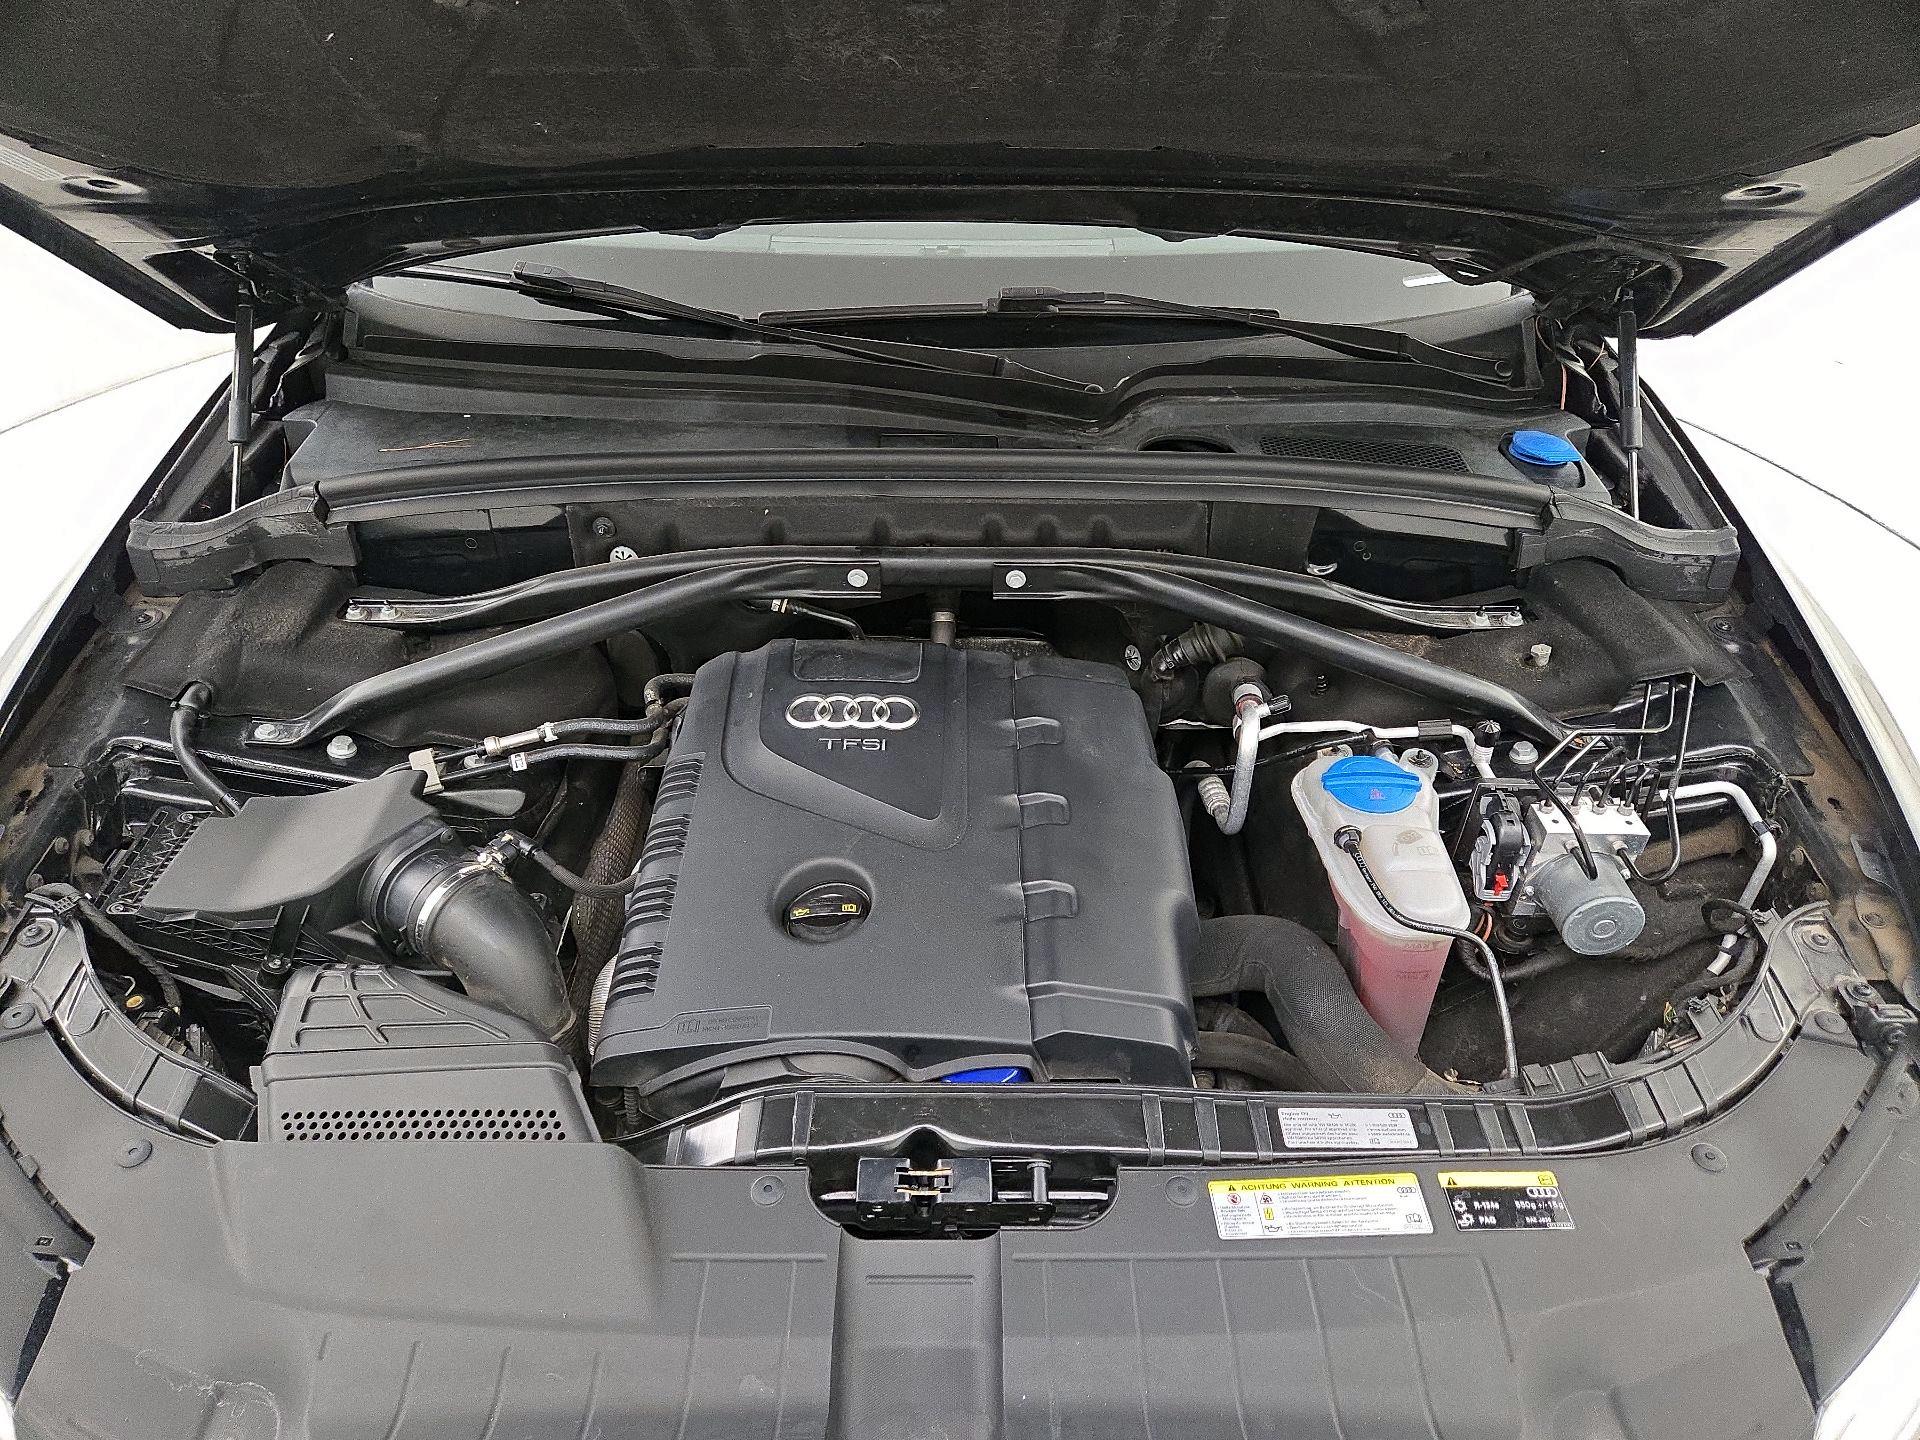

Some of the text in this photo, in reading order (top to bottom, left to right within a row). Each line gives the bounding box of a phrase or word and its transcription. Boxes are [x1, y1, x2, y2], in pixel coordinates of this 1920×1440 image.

[817, 738, 887, 751] TFSI
[1241, 1178, 1396, 1191] ACHTUNG WARNING ATTENTION
